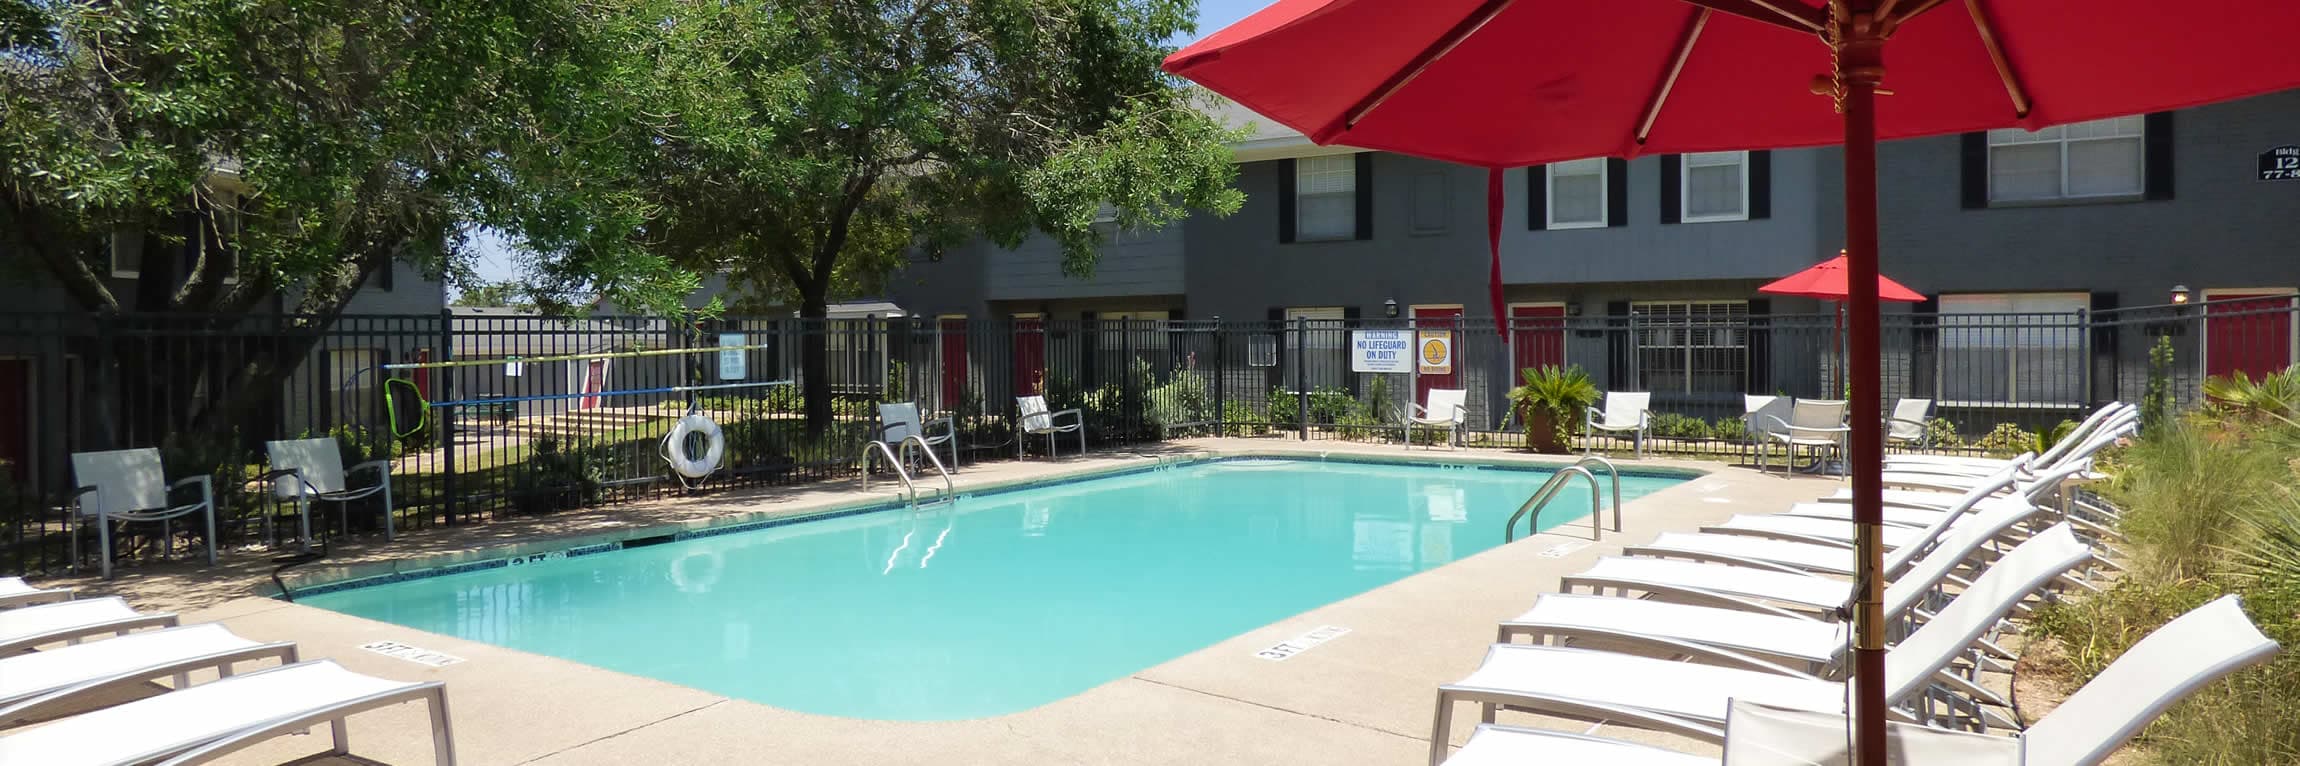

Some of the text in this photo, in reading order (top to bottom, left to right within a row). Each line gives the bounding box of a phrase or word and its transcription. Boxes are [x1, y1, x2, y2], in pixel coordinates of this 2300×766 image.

[2276, 157, 2299, 169] 12
[1357, 340, 1407, 349] NO LIFEGUARD
[1367, 350, 1397, 359] ON DUTY
